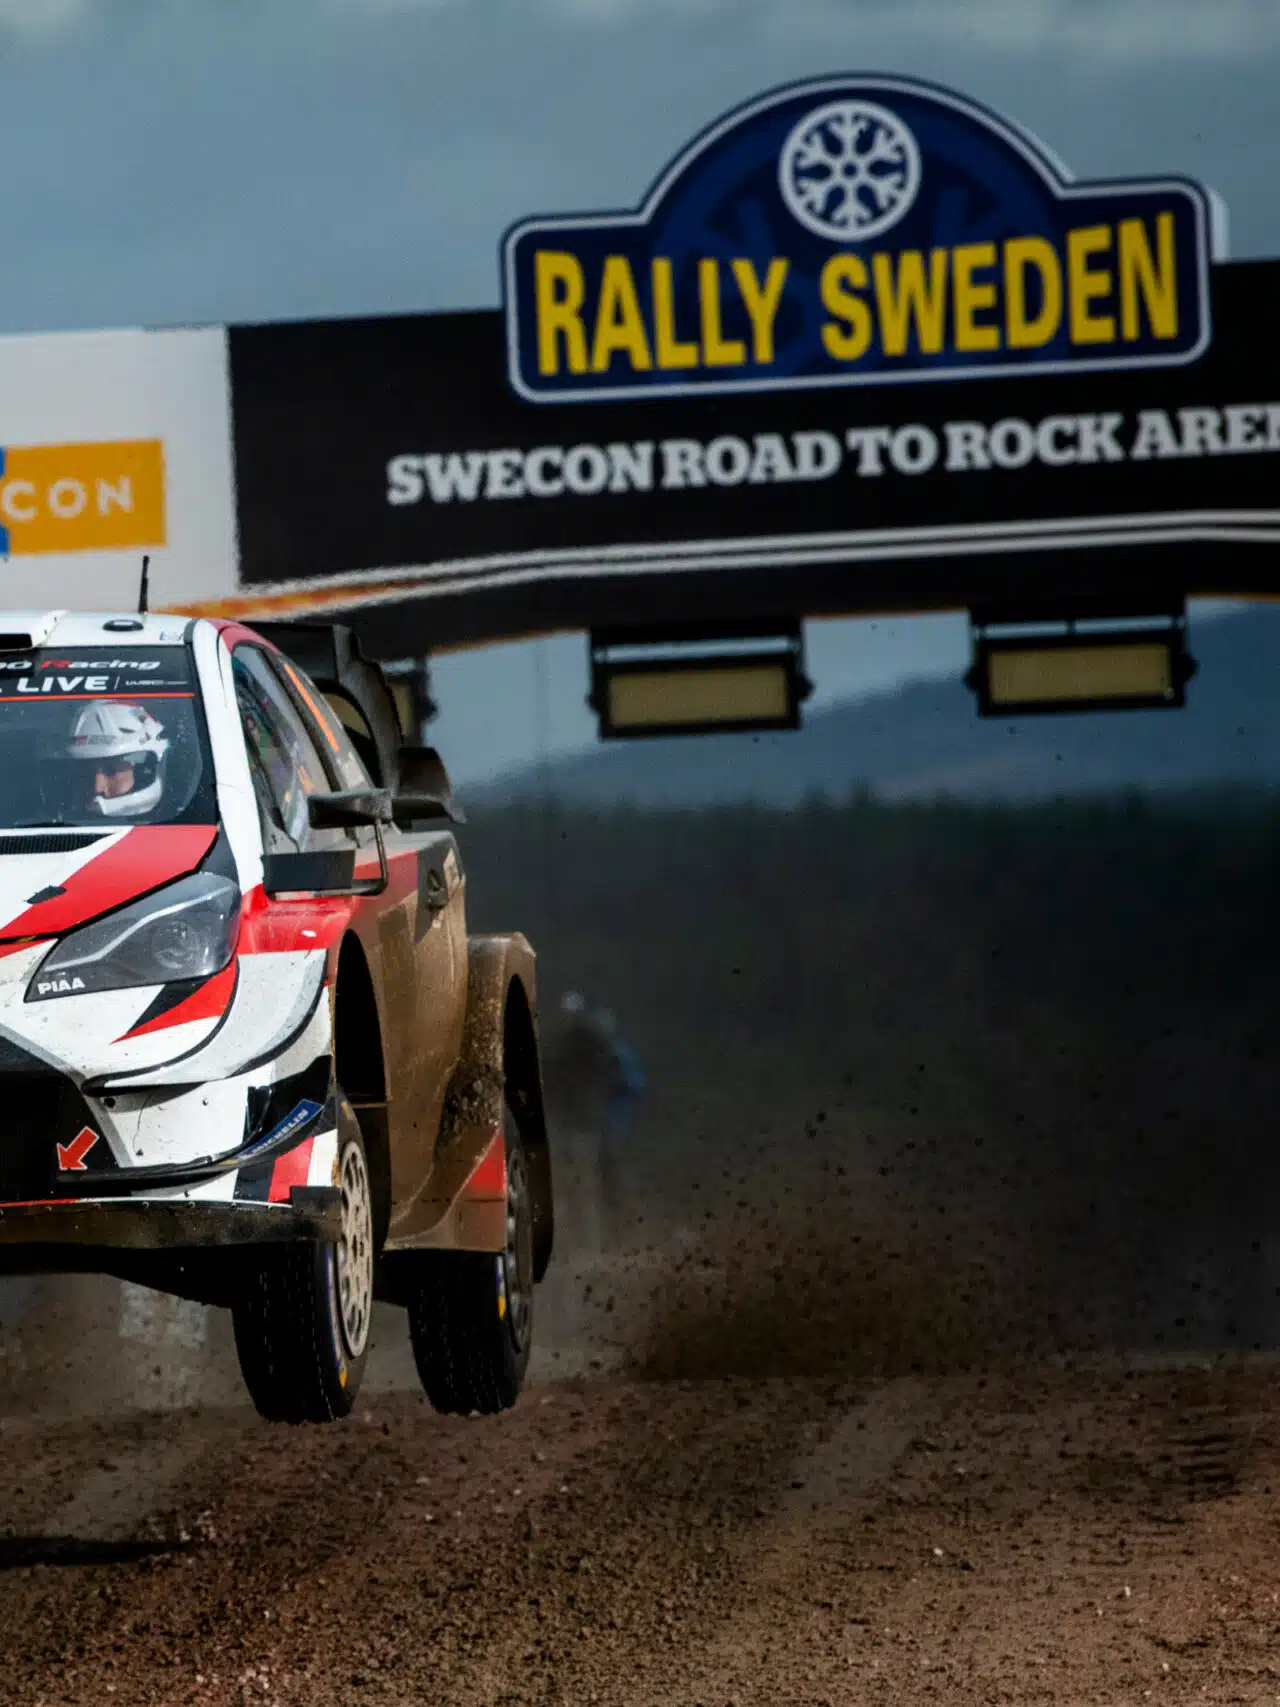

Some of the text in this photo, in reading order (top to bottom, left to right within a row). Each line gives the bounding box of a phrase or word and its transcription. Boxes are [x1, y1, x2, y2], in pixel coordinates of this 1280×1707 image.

[534, 212, 1178, 376] RALLY SWEDEN
[386, 401, 1280, 506] SWECON ROAD TO ROCK ARE
[16, 675, 109, 693] LIVE
[37, 976, 86, 995] PIAA
